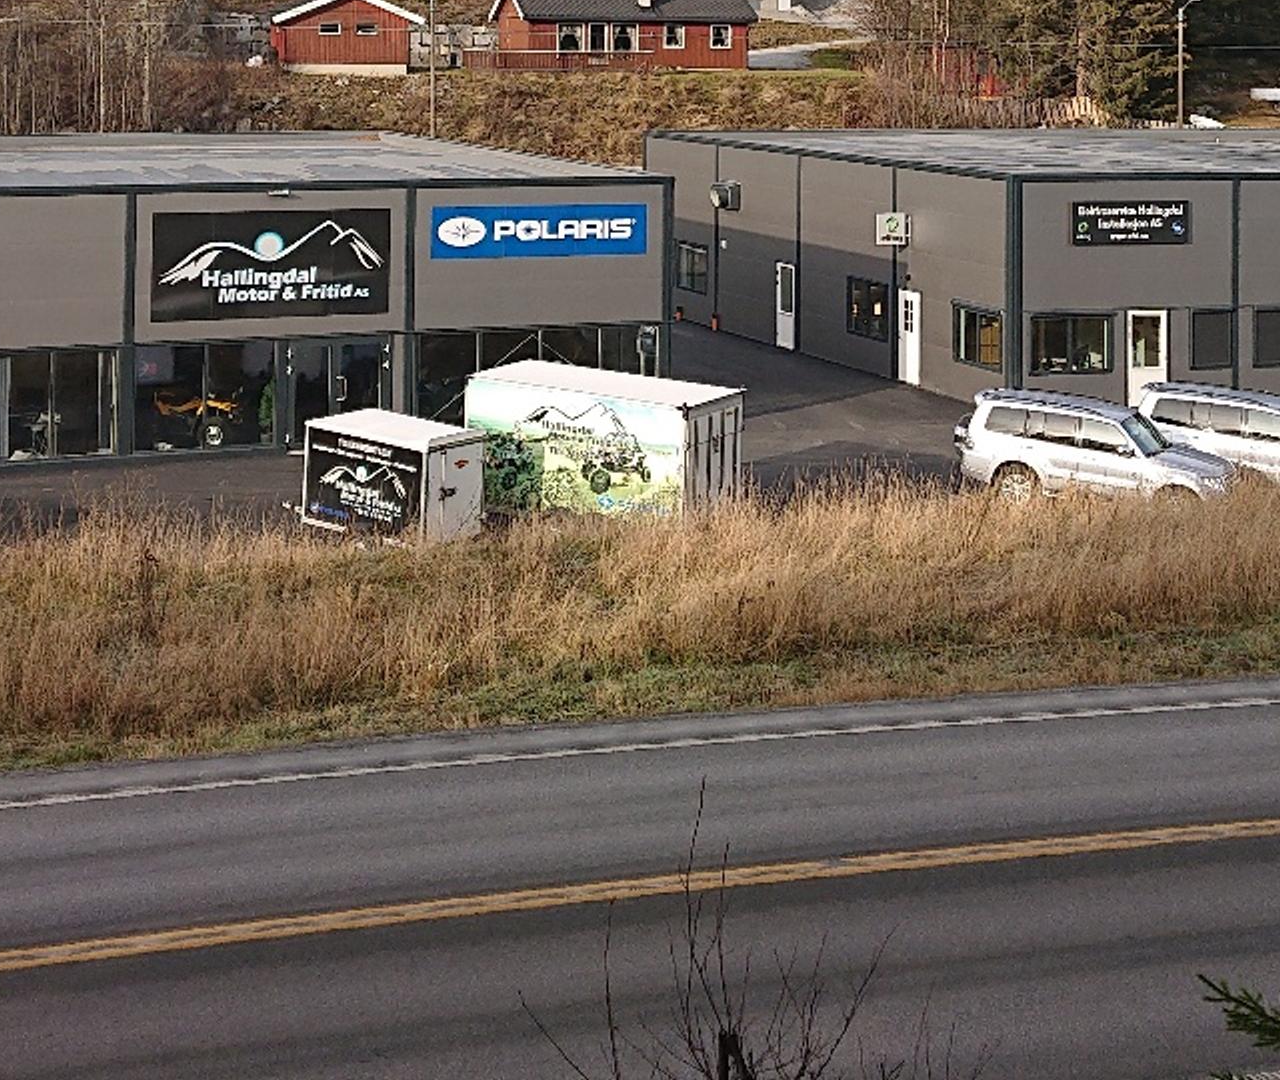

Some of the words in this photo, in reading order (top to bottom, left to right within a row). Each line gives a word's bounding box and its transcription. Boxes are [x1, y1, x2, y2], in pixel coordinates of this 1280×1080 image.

[493, 218, 632, 241] POLARIS
[202, 266, 317, 289] Hallingdal
[218, 287, 277, 303] Motor
[282, 286, 297, 300] &
[301, 284, 353, 299] Fritid
[354, 288, 370, 297] AS
